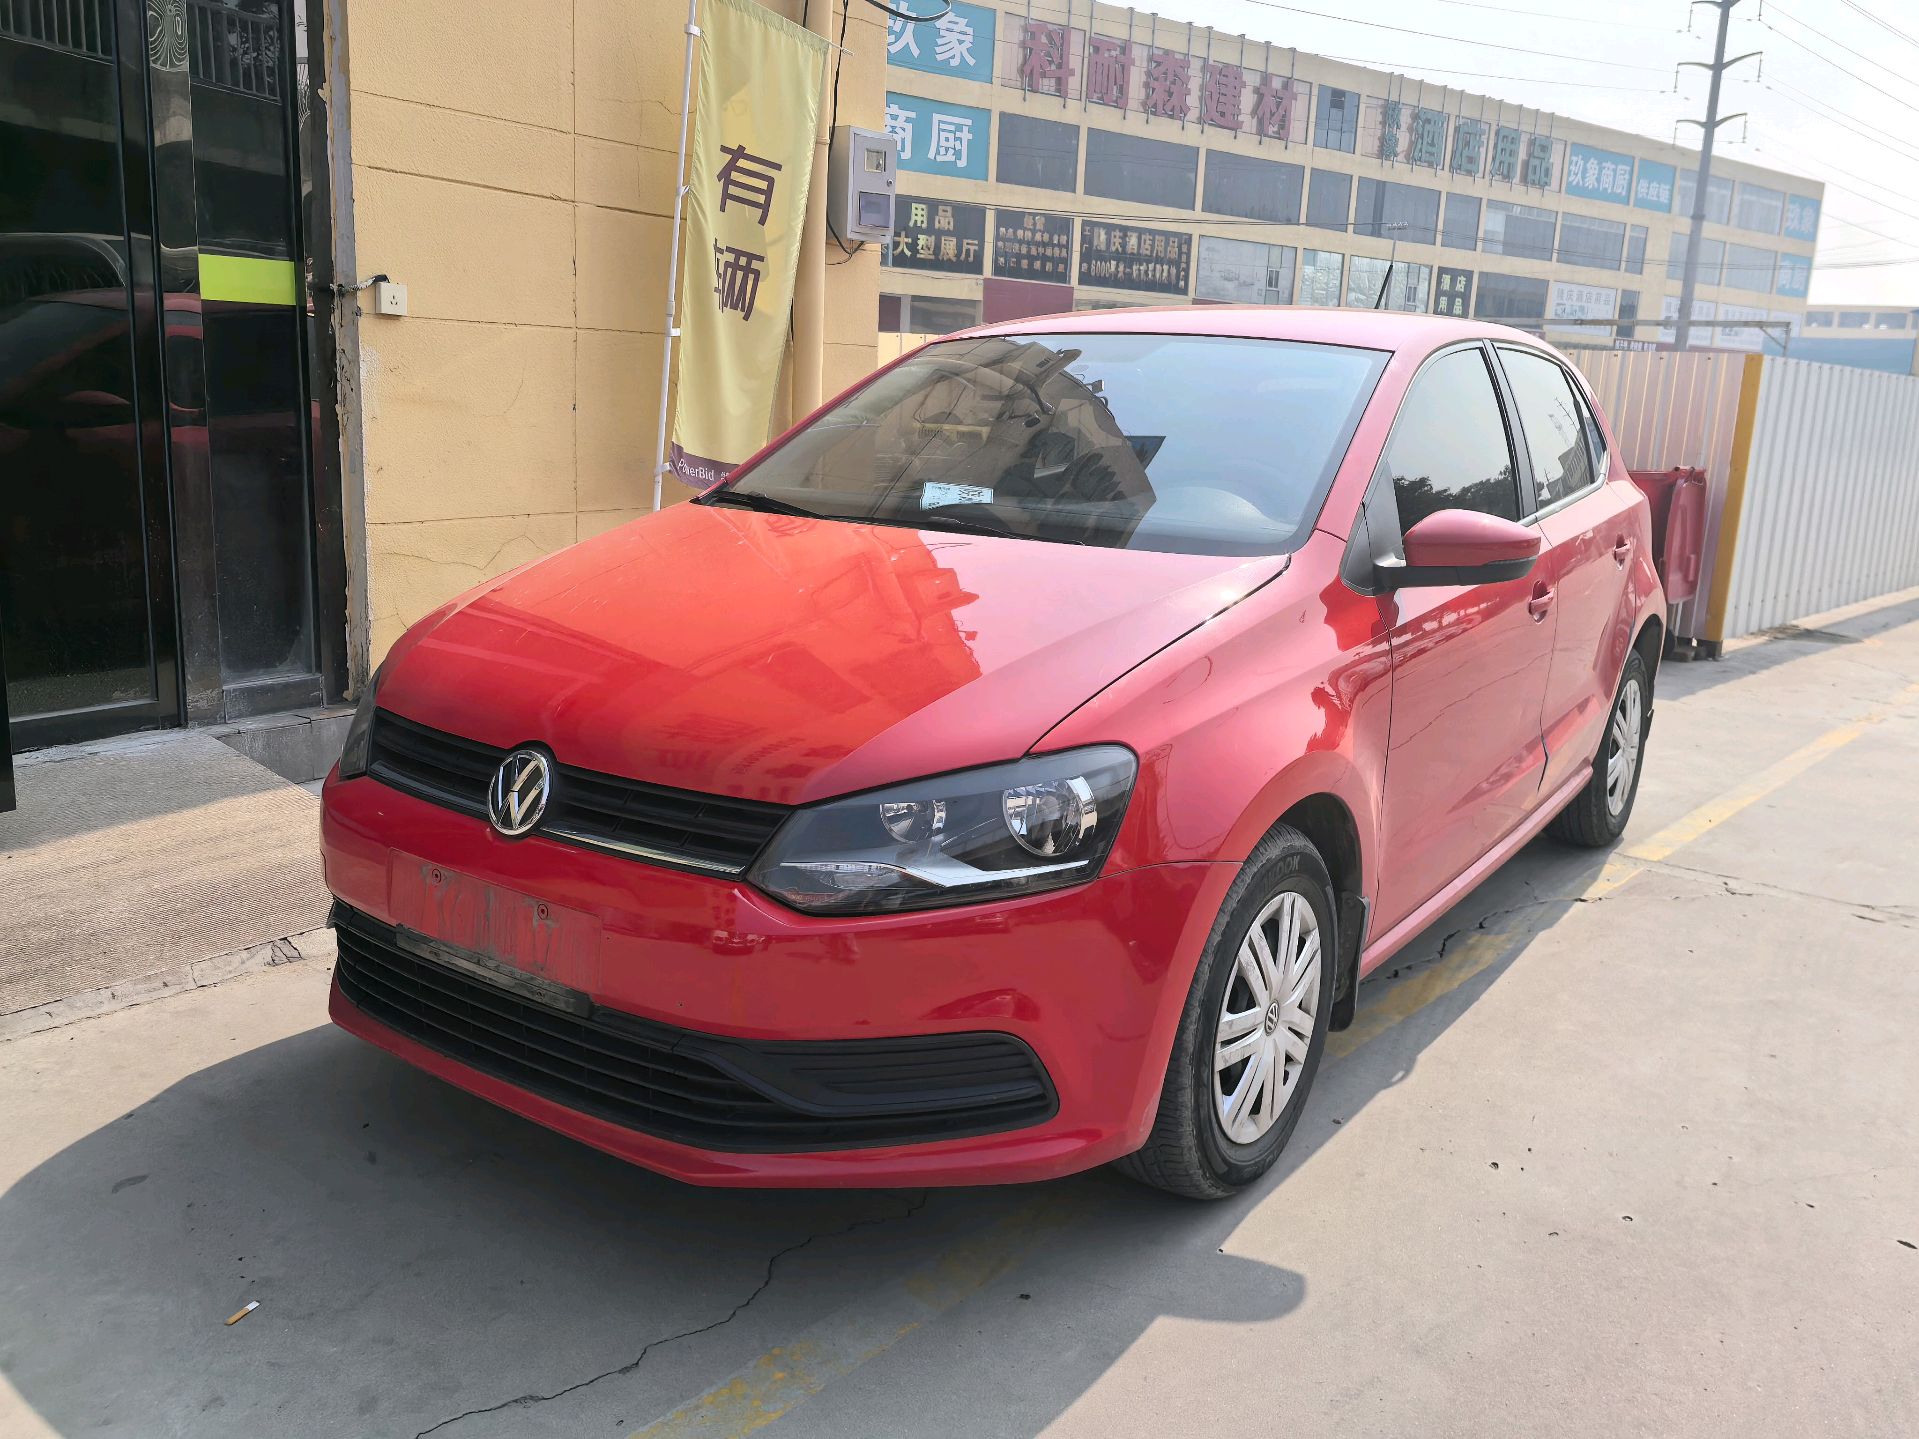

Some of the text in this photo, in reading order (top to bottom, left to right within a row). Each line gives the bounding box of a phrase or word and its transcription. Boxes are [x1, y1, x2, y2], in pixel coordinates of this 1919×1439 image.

[1021, 23, 1297, 140] 科耐森建材
[1412, 107, 1554, 187] 酒店用品
[1569, 155, 1631, 196] 玖象商厨
[909, 203, 954, 231] 用品
[892, 230, 979, 262] 大型展厅
[1440, 273, 1467, 293] 酒店
[1438, 296, 1463, 317] 用品
